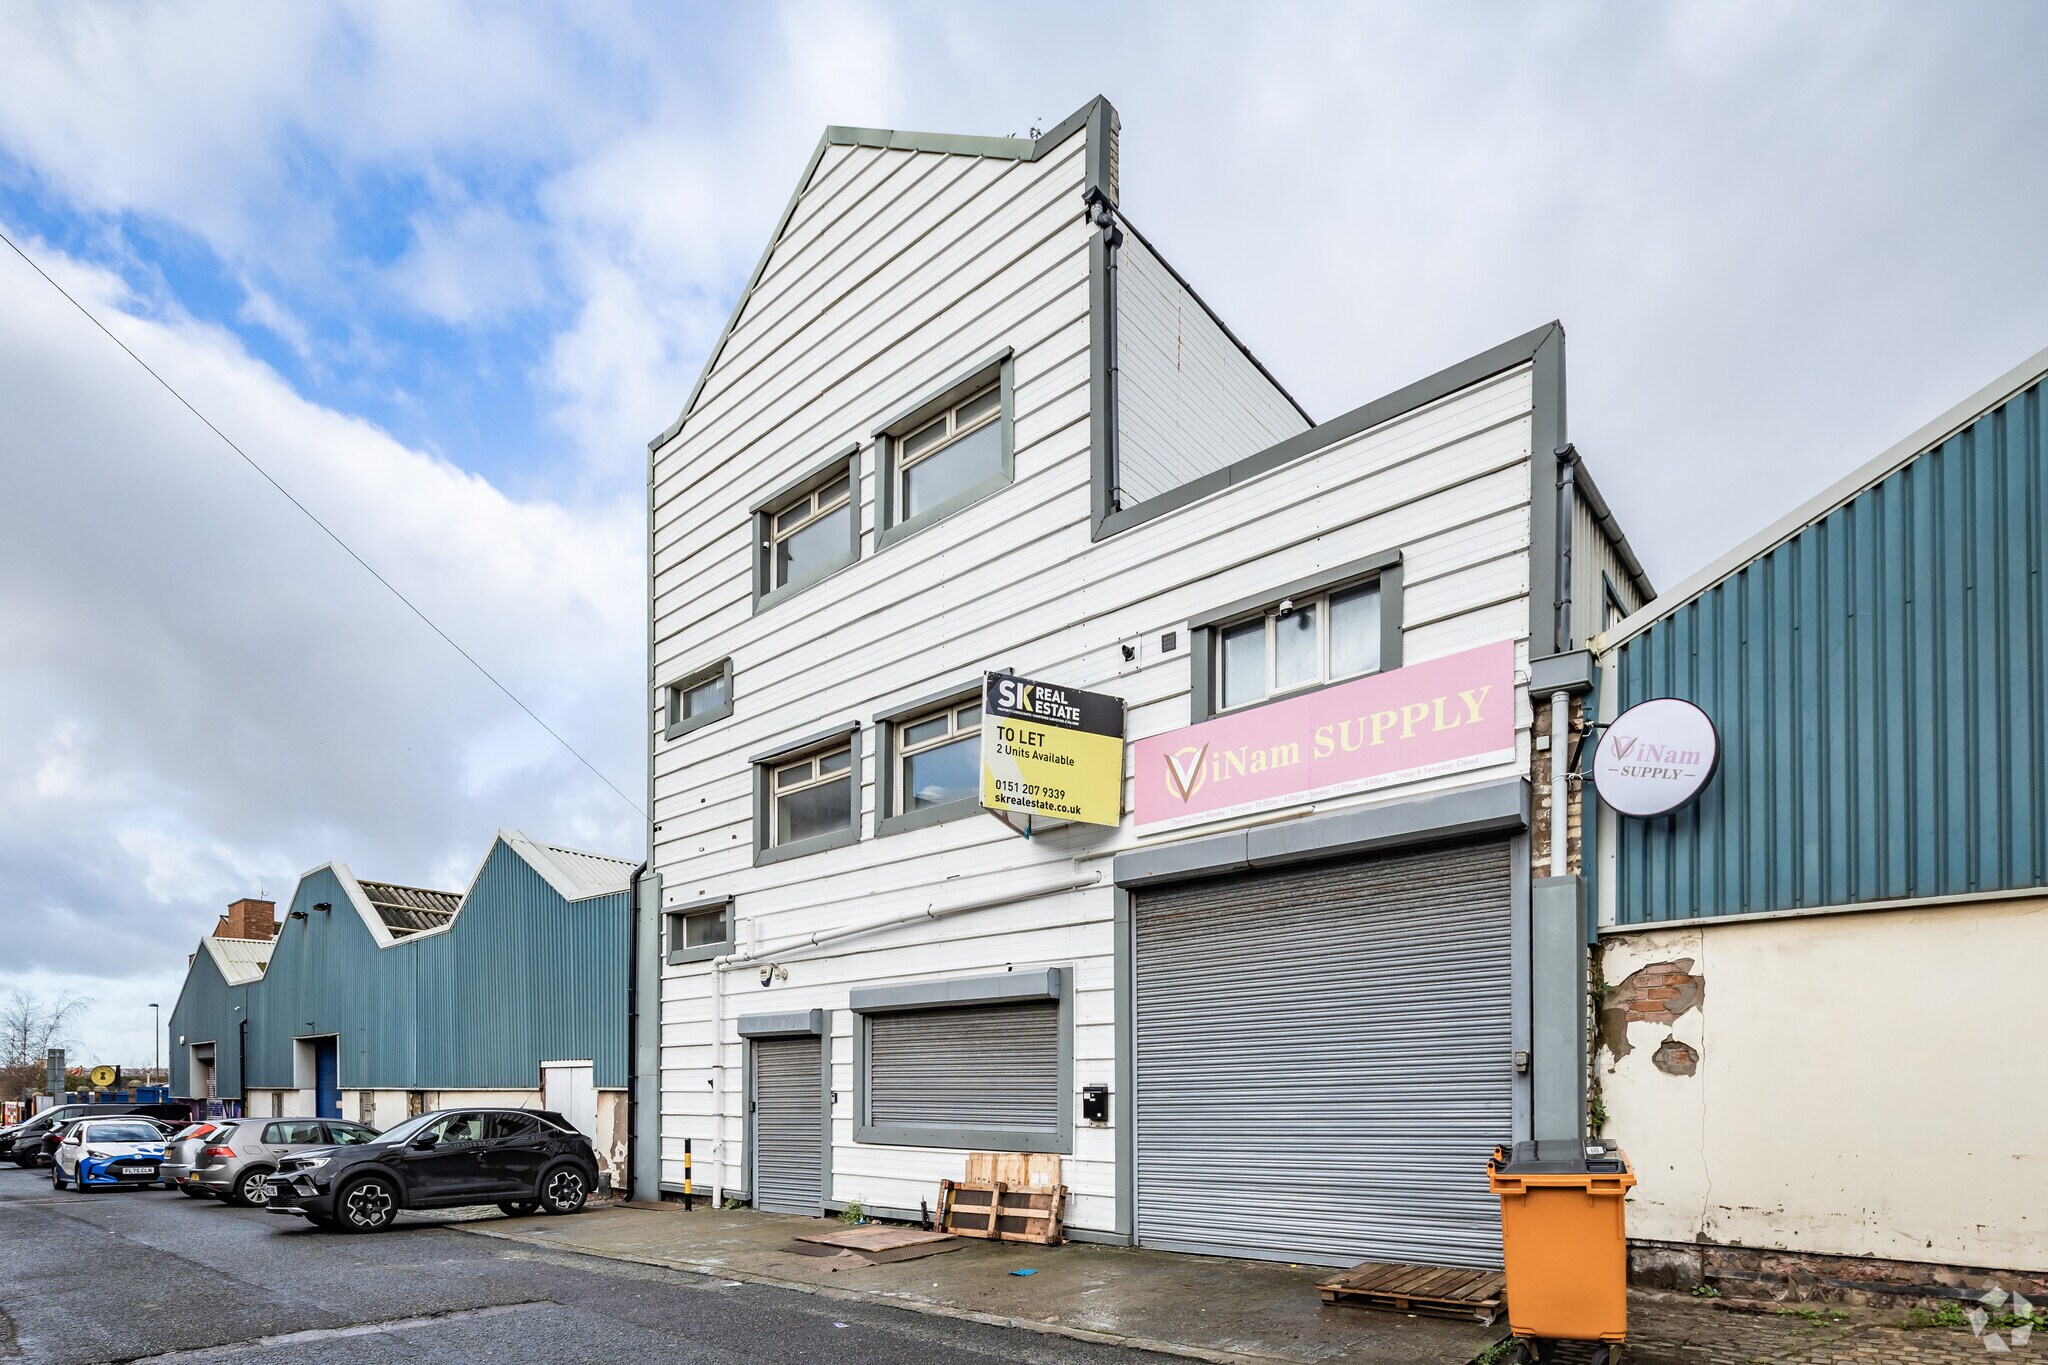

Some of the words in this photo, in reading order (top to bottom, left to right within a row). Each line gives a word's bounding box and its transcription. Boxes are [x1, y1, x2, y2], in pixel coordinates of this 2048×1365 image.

[998, 680, 1034, 712] SK
[1035, 686, 1068, 705] REAL
[1035, 701, 1080, 721] ESTATE
[997, 725, 1015, 742] TO
[1019, 729, 1045, 747] LET
[1163, 741, 1300, 804] ViNam
[1312, 684, 1493, 760] SUPPLY
[996, 743, 1002, 753] 2
[1005, 744, 1030, 758] Units
[1032, 750, 1075, 766] Available
[1611, 735, 1701, 765] ViNam
[1395, 769, 1415, 779] Friday
[1456, 757, 1479, 767] Closed
[1621, 765, 1683, 780] SUPPLY
[995, 779, 1019, 793] 0151
[1022, 783, 1040, 796] 207
[1042, 787, 1066, 800] 9339
[995, 793, 1081, 815] skrealestate.co.uk
